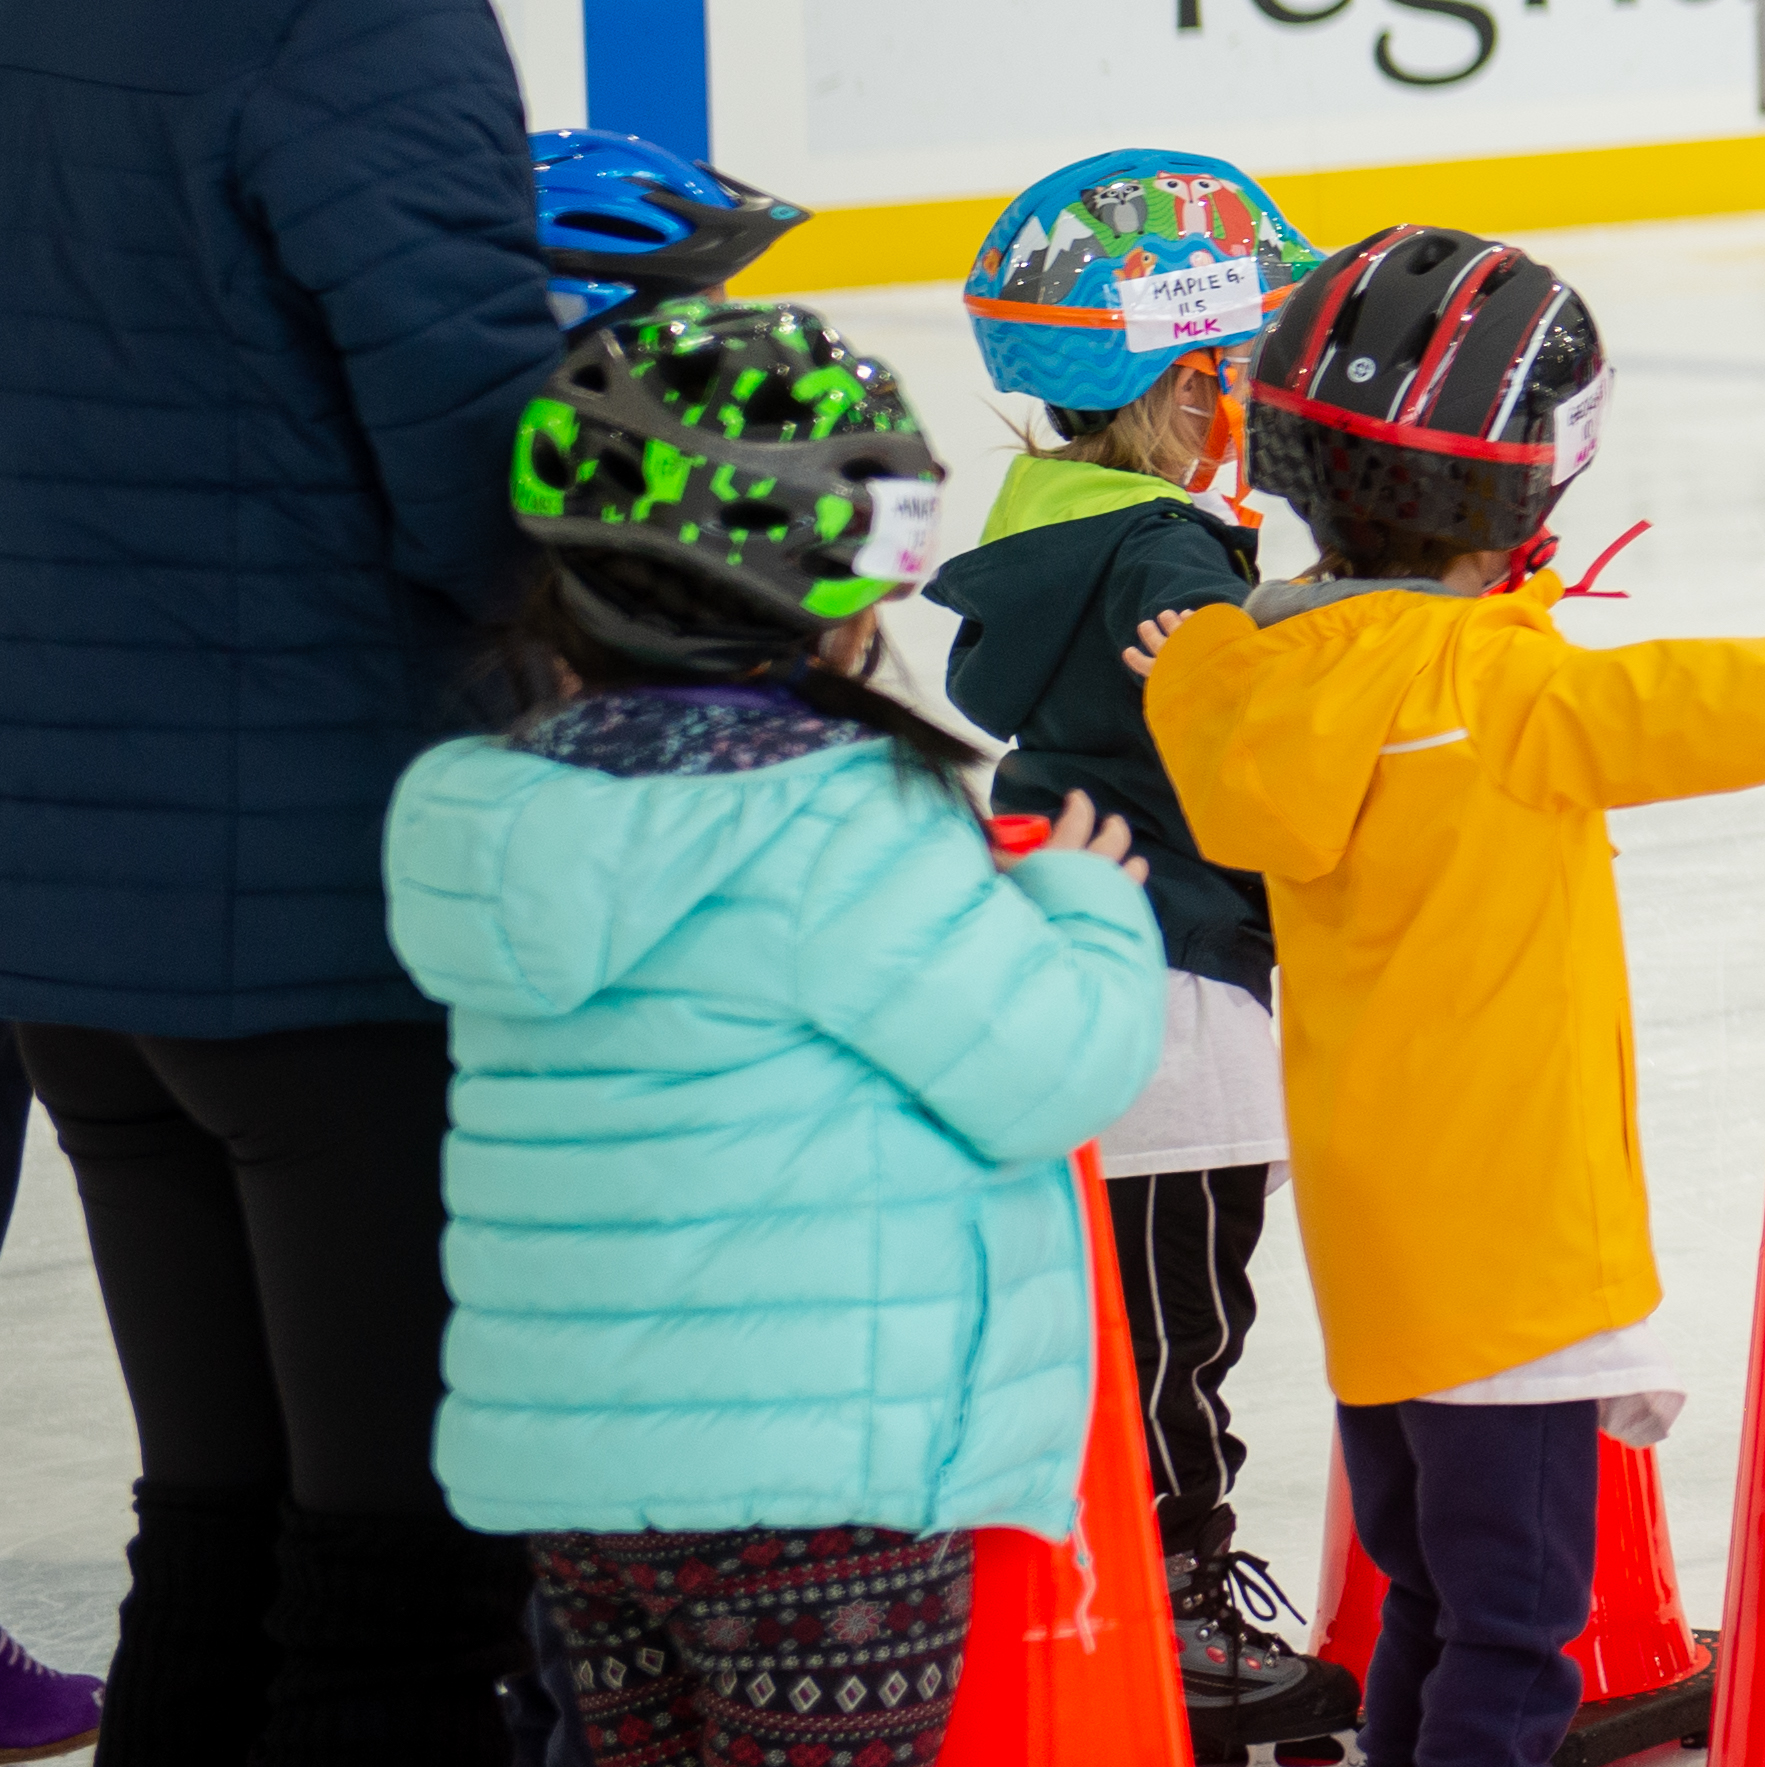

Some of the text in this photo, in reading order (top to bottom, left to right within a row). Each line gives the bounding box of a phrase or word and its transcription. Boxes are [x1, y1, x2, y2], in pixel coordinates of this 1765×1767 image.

[1153, 267, 1246, 301] MAPLE G.
[1178, 298, 1208, 317] 11.5
[1172, 318, 1223, 339] MLK
